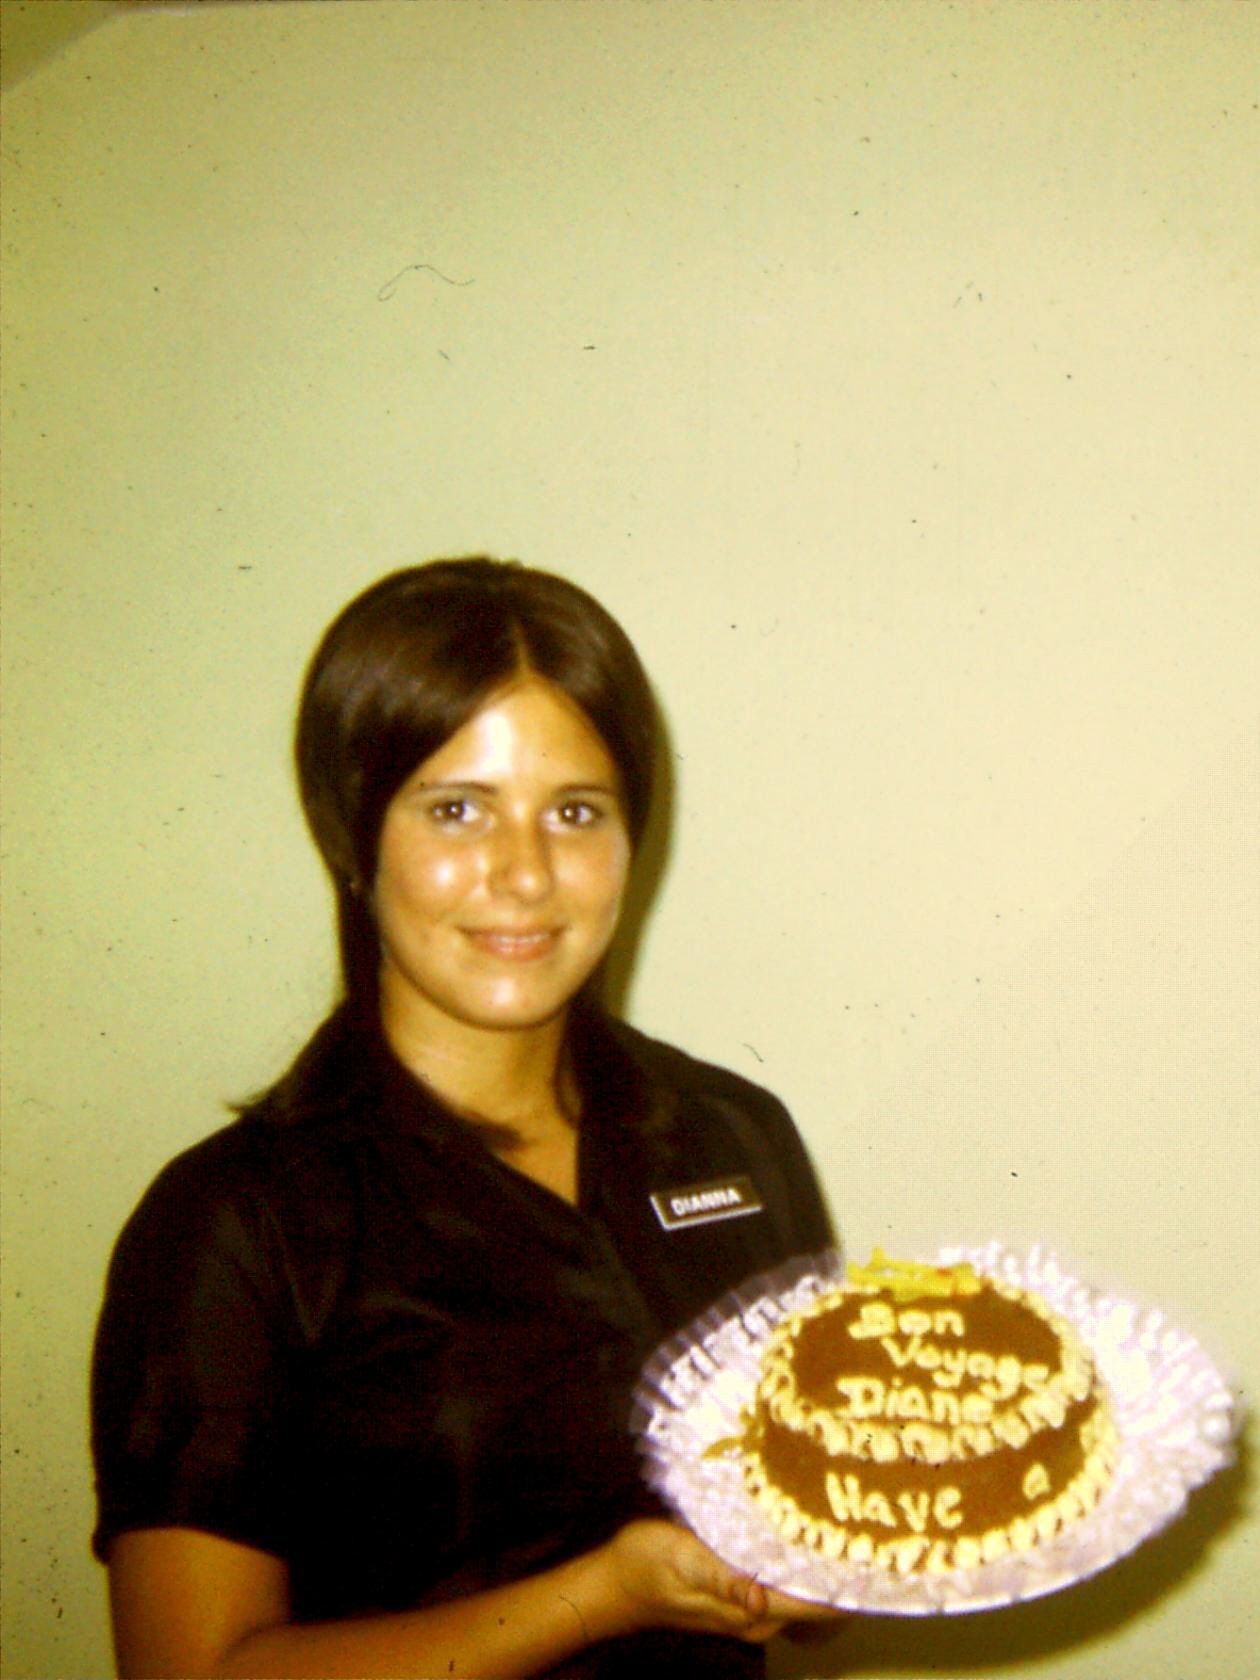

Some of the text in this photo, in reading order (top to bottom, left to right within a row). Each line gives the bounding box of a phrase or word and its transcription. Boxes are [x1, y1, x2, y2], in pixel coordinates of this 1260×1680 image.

[670, 1187, 742, 1216] DIANNA
[849, 1302, 964, 1339] Bon
[880, 1335, 1049, 1401] Voyage
[826, 1463, 1050, 1533] Have a
